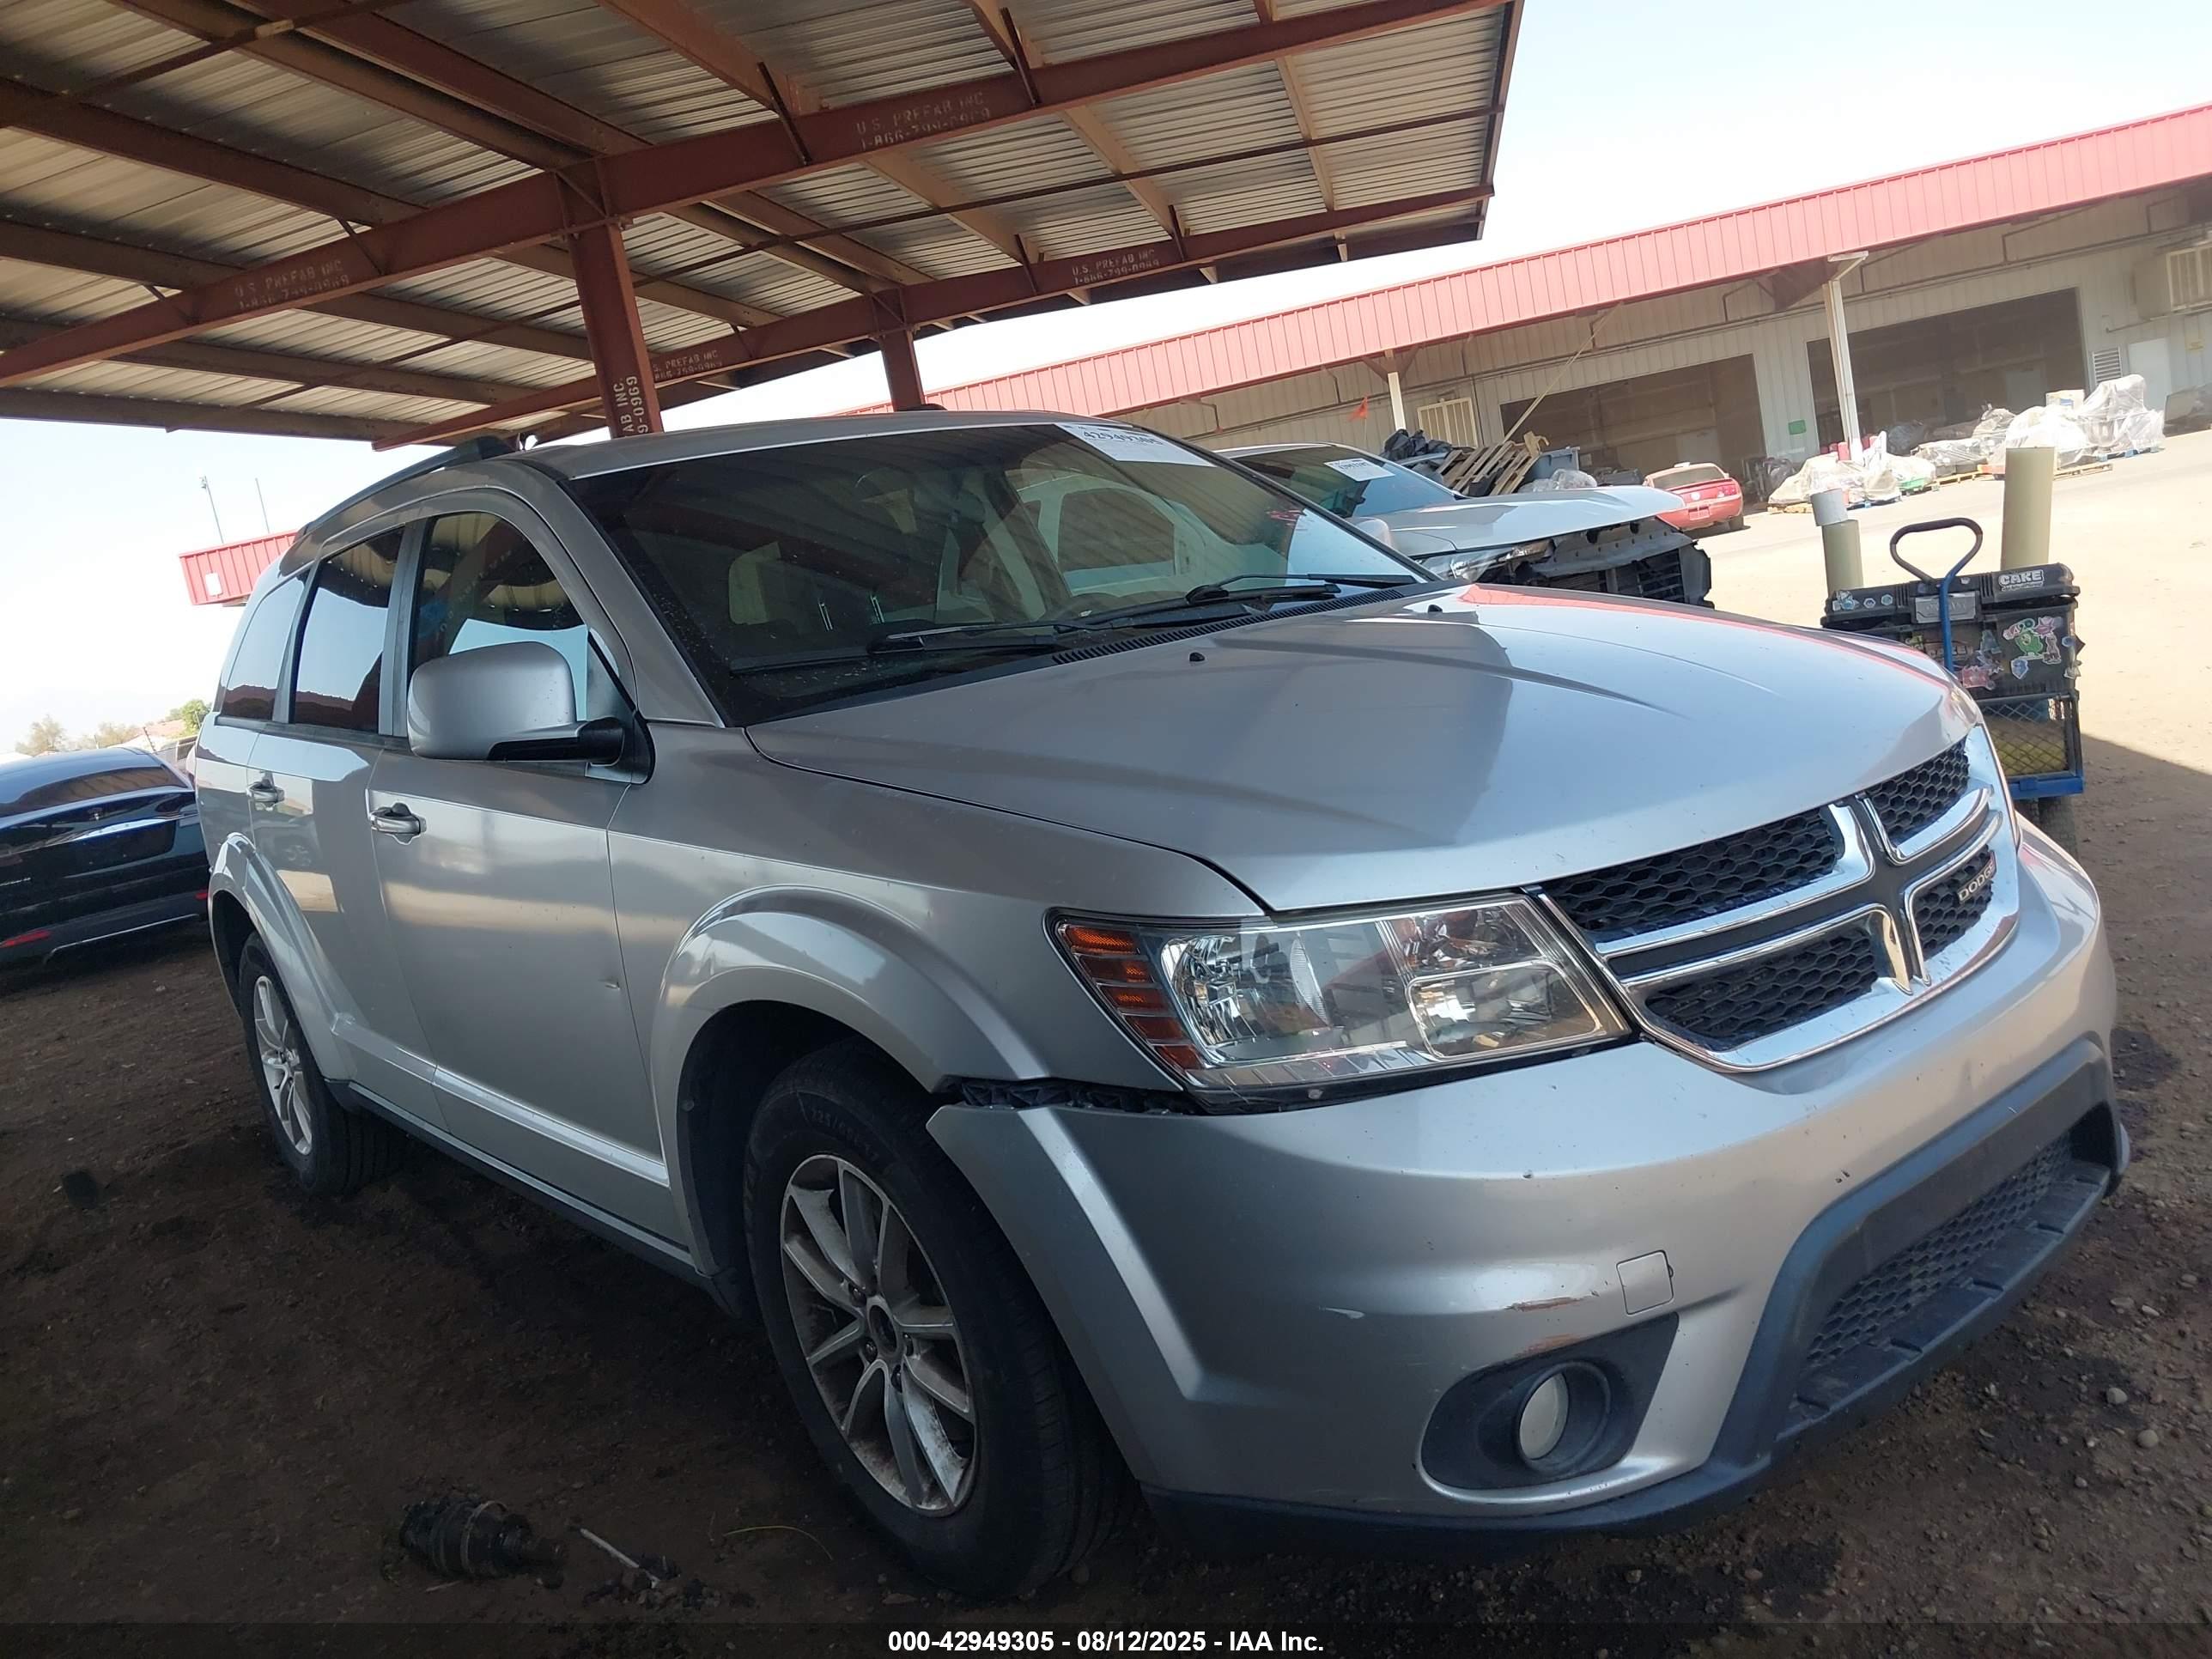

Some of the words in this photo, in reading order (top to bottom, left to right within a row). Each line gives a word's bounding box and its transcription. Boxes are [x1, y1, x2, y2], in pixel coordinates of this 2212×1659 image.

[239, 274, 350, 310] 1-866799-0969
[1999, 569, 2042, 586] CAKE
[1958, 862, 1994, 901] DODGE
